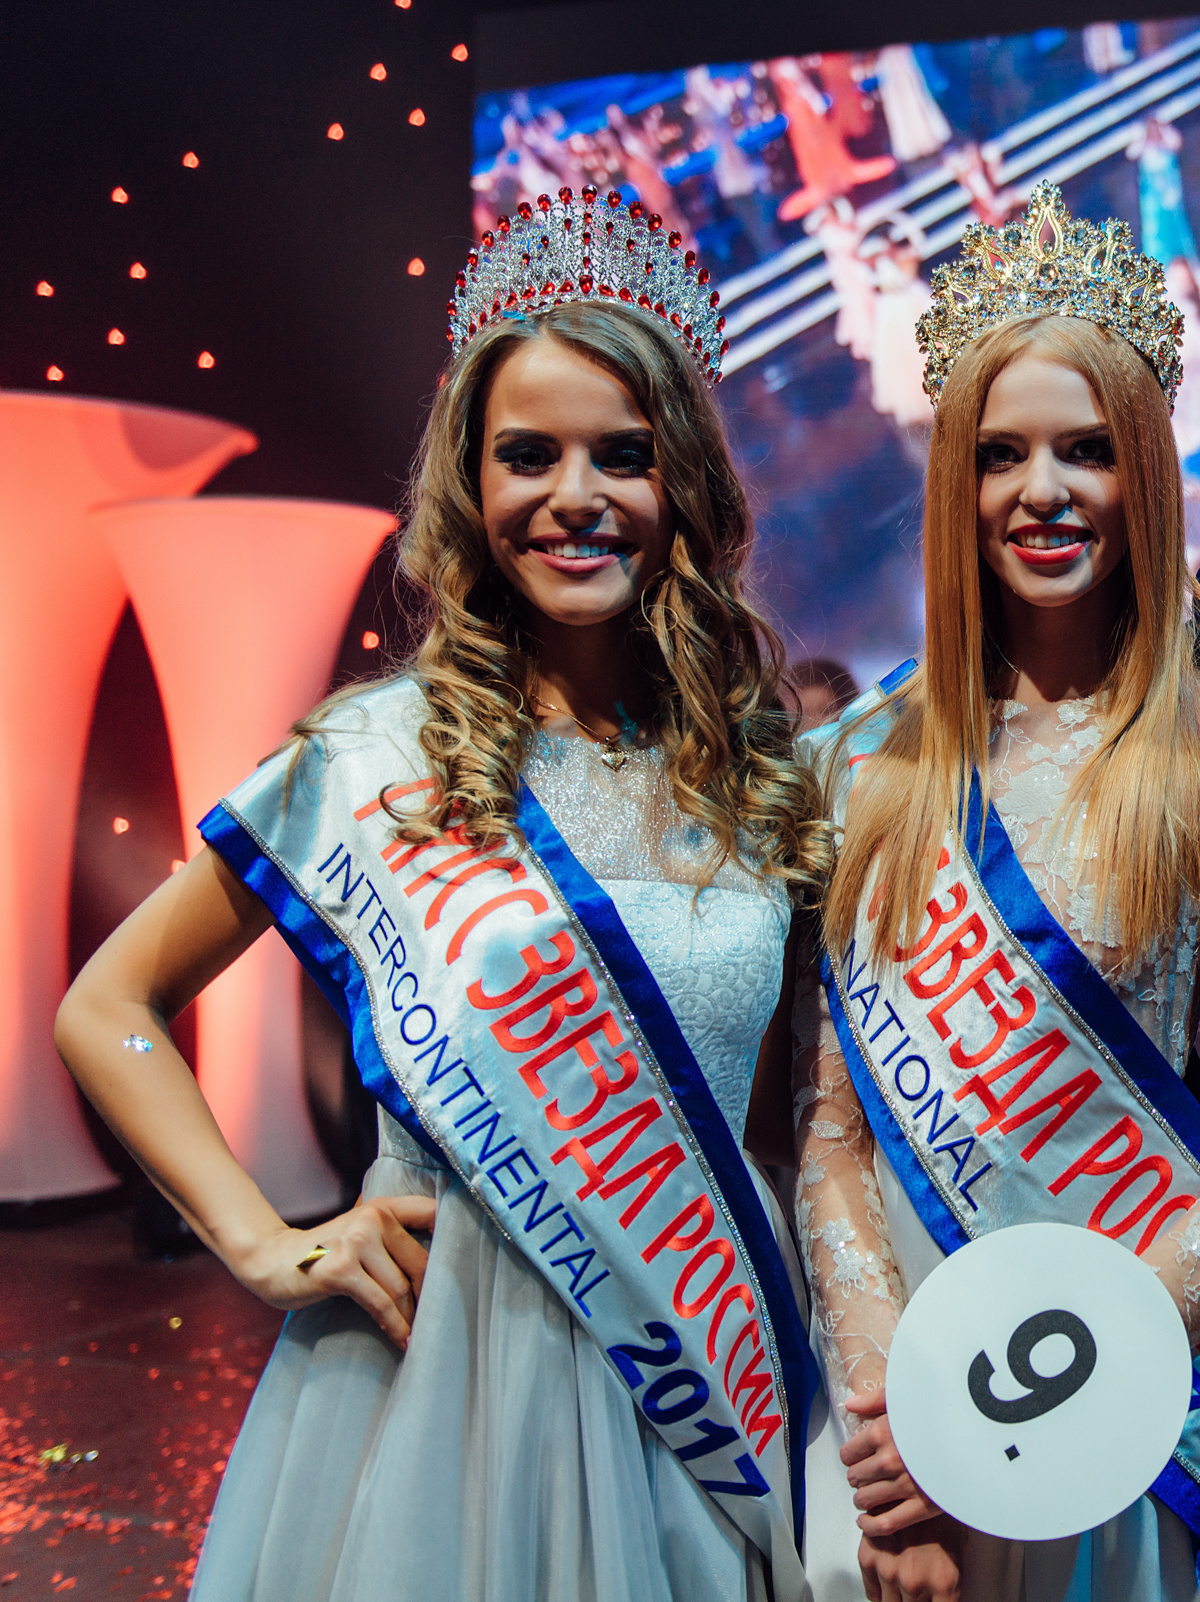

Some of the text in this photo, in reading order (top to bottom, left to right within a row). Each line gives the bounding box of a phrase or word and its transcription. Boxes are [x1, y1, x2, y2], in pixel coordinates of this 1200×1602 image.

[317, 842, 771, 1500] INTERCONTINENTAL 2017
[467, 930, 687, 1230] ЗВЕЗДА
[641, 1193, 782, 1458] РОССИИ
[890, 880, 1101, 1163] ЗВЕЗДА
